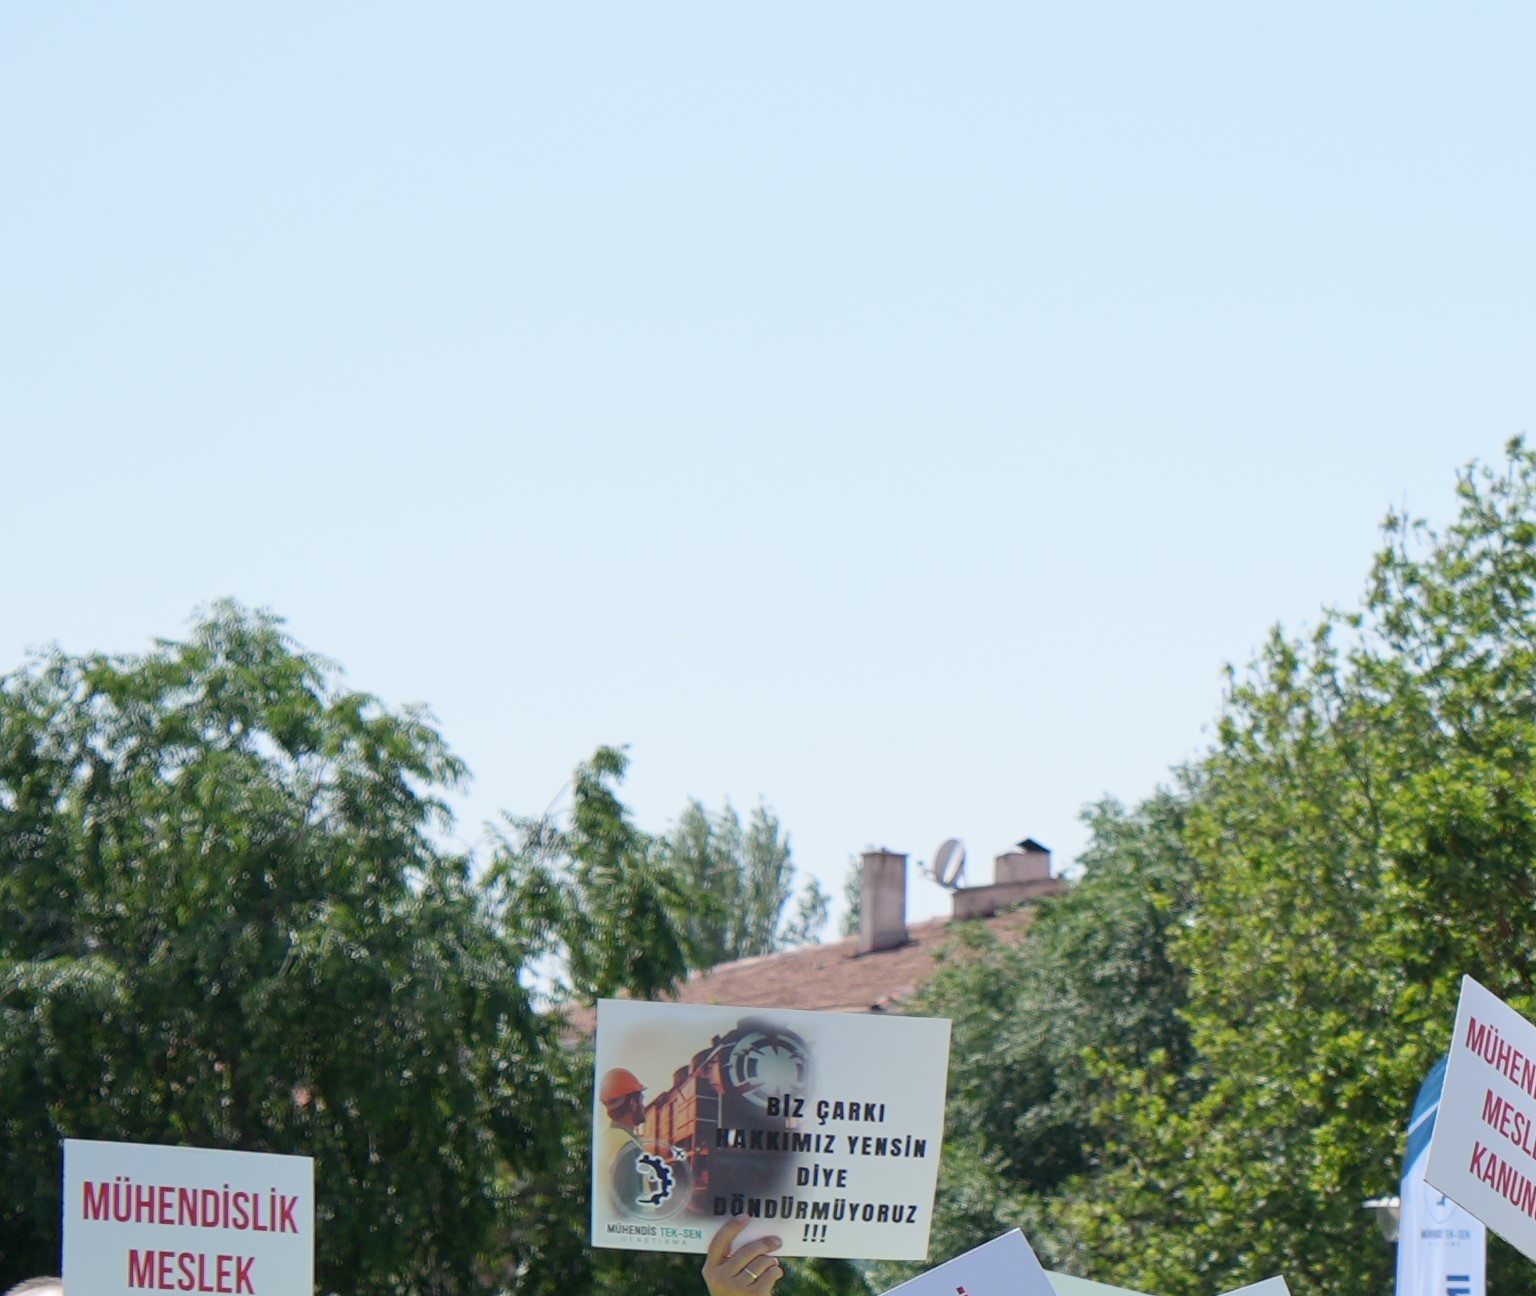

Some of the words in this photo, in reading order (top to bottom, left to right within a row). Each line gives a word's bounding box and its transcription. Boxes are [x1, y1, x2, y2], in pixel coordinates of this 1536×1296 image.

[767, 1094, 804, 1118] BİZ
[817, 1101, 885, 1126] ÇARKI
[716, 1128, 835, 1154] HAKKIMIZ
[847, 1135, 927, 1158] YENSİN
[797, 1166, 848, 1188] DİYE
[82, 1176, 300, 1234] MÜHENDİSLİK
[713, 1193, 918, 1223] DÖNDÜRMÜYORUZ
[660, 1227, 703, 1239] TEK-SEN
[126, 1249, 255, 1296] MESLEK
